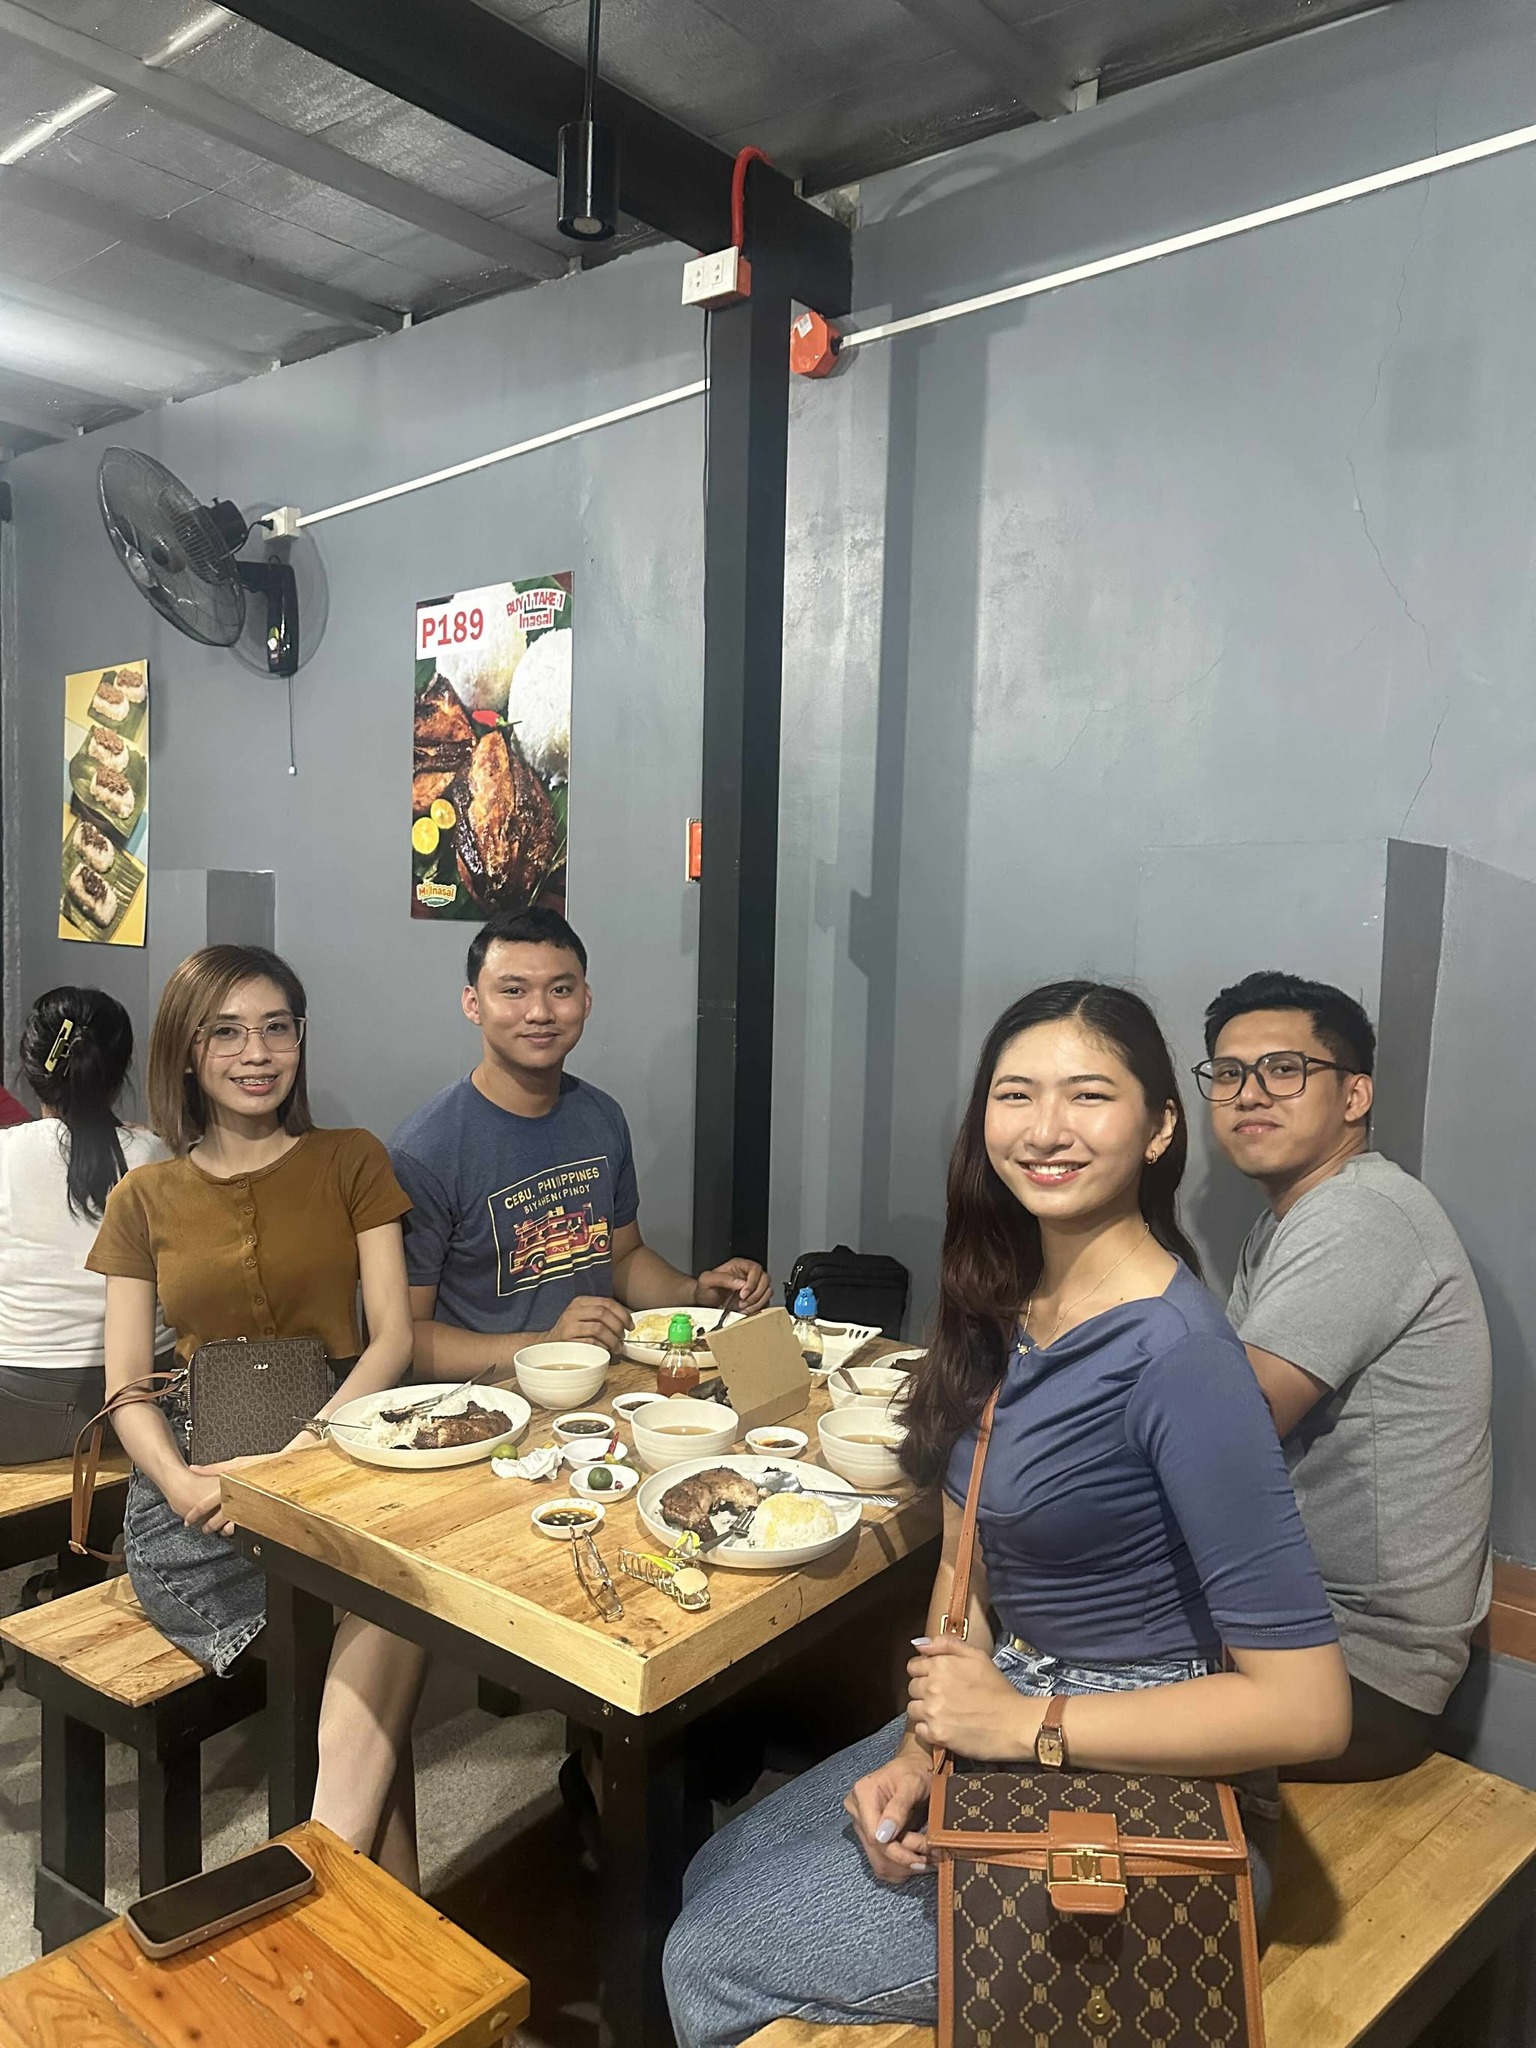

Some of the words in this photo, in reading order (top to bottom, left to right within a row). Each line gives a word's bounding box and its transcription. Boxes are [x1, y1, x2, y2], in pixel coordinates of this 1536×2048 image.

[506, 596, 525, 617] BUY
[533, 591, 557, 606] TAKE
[422, 608, 484, 649] P189
[519, 608, 552, 629] Inasal
[562, 1184, 590, 1198] PINOY
